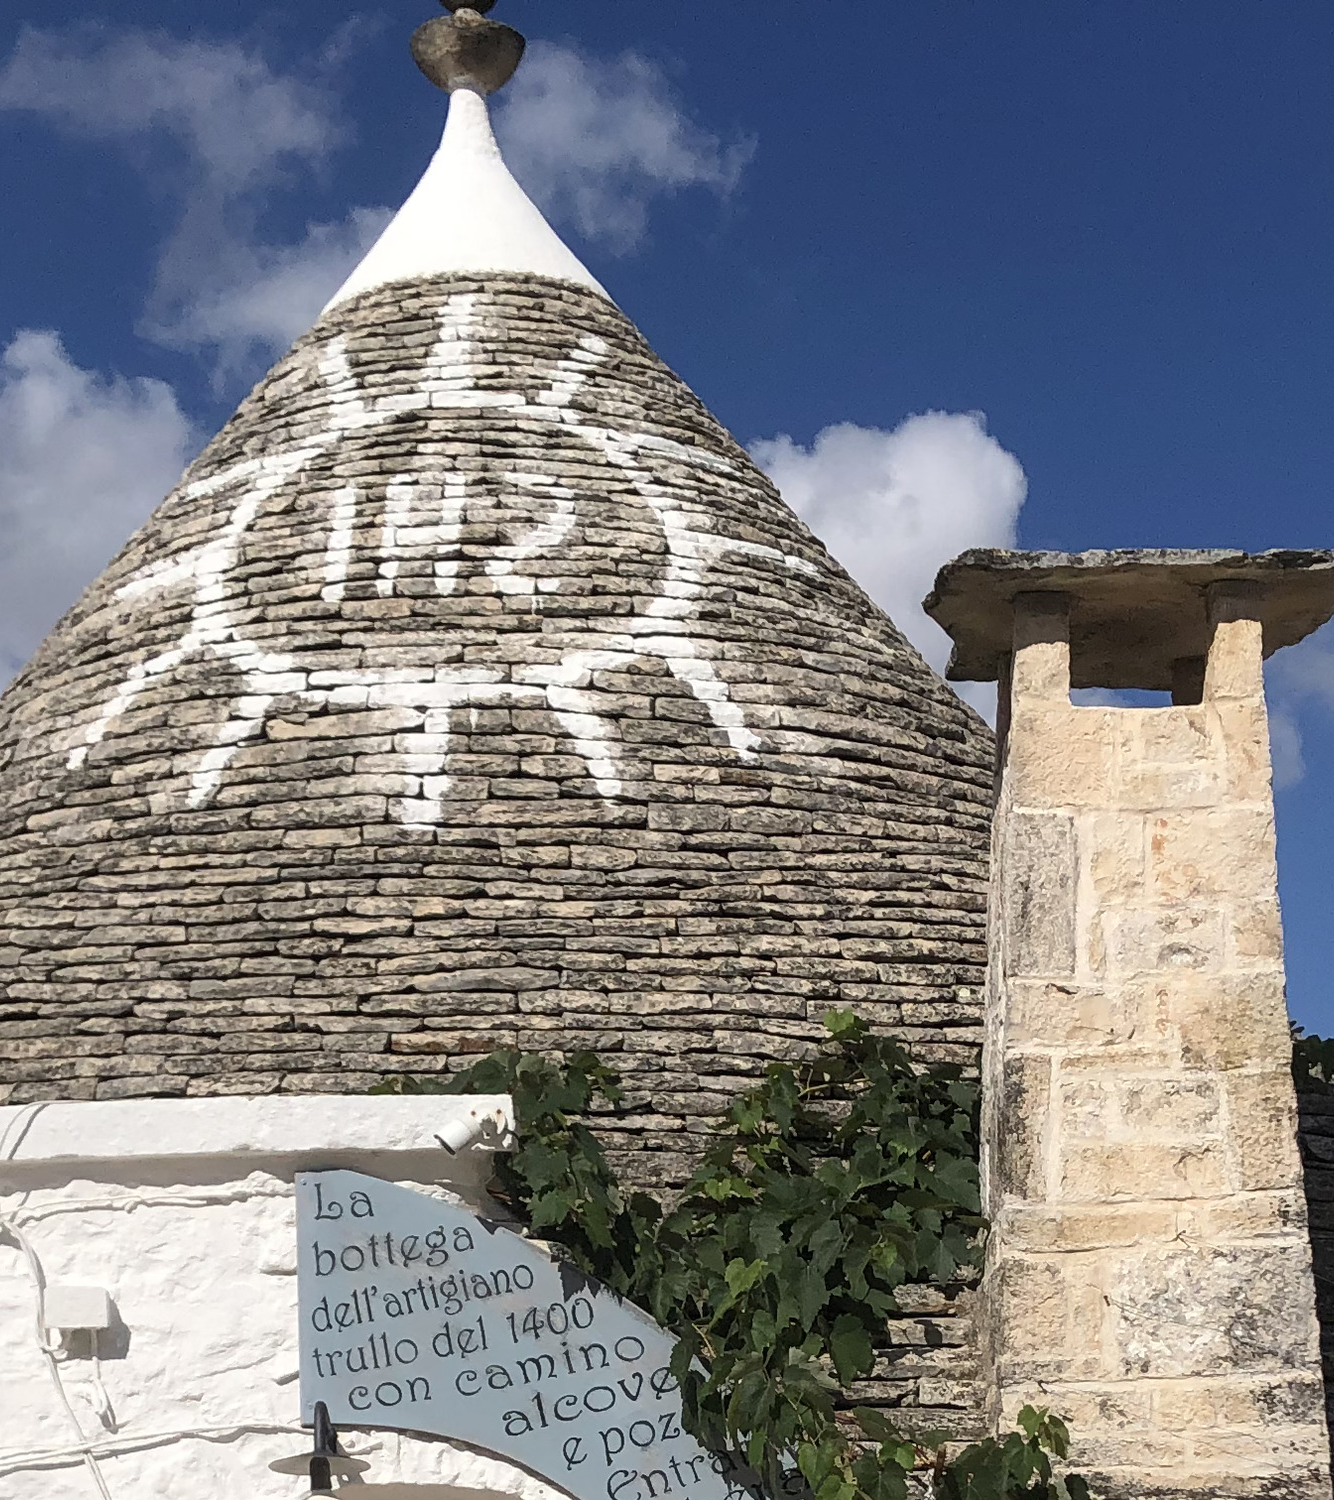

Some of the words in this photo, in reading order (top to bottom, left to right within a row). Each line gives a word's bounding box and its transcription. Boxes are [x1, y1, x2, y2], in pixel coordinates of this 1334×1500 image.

[313, 1182, 375, 1221] La
[312, 1225, 475, 1277] bottega
[311, 1263, 535, 1333] dell'artigiano
[312, 1332, 419, 1379] trullo
[432, 1316, 489, 1360] del
[506, 1297, 596, 1344] 1400
[348, 1374, 432, 1412] con
[455, 1334, 646, 1397] camino
[563, 1436, 588, 1471] e
[598, 1411, 681, 1467] poz
